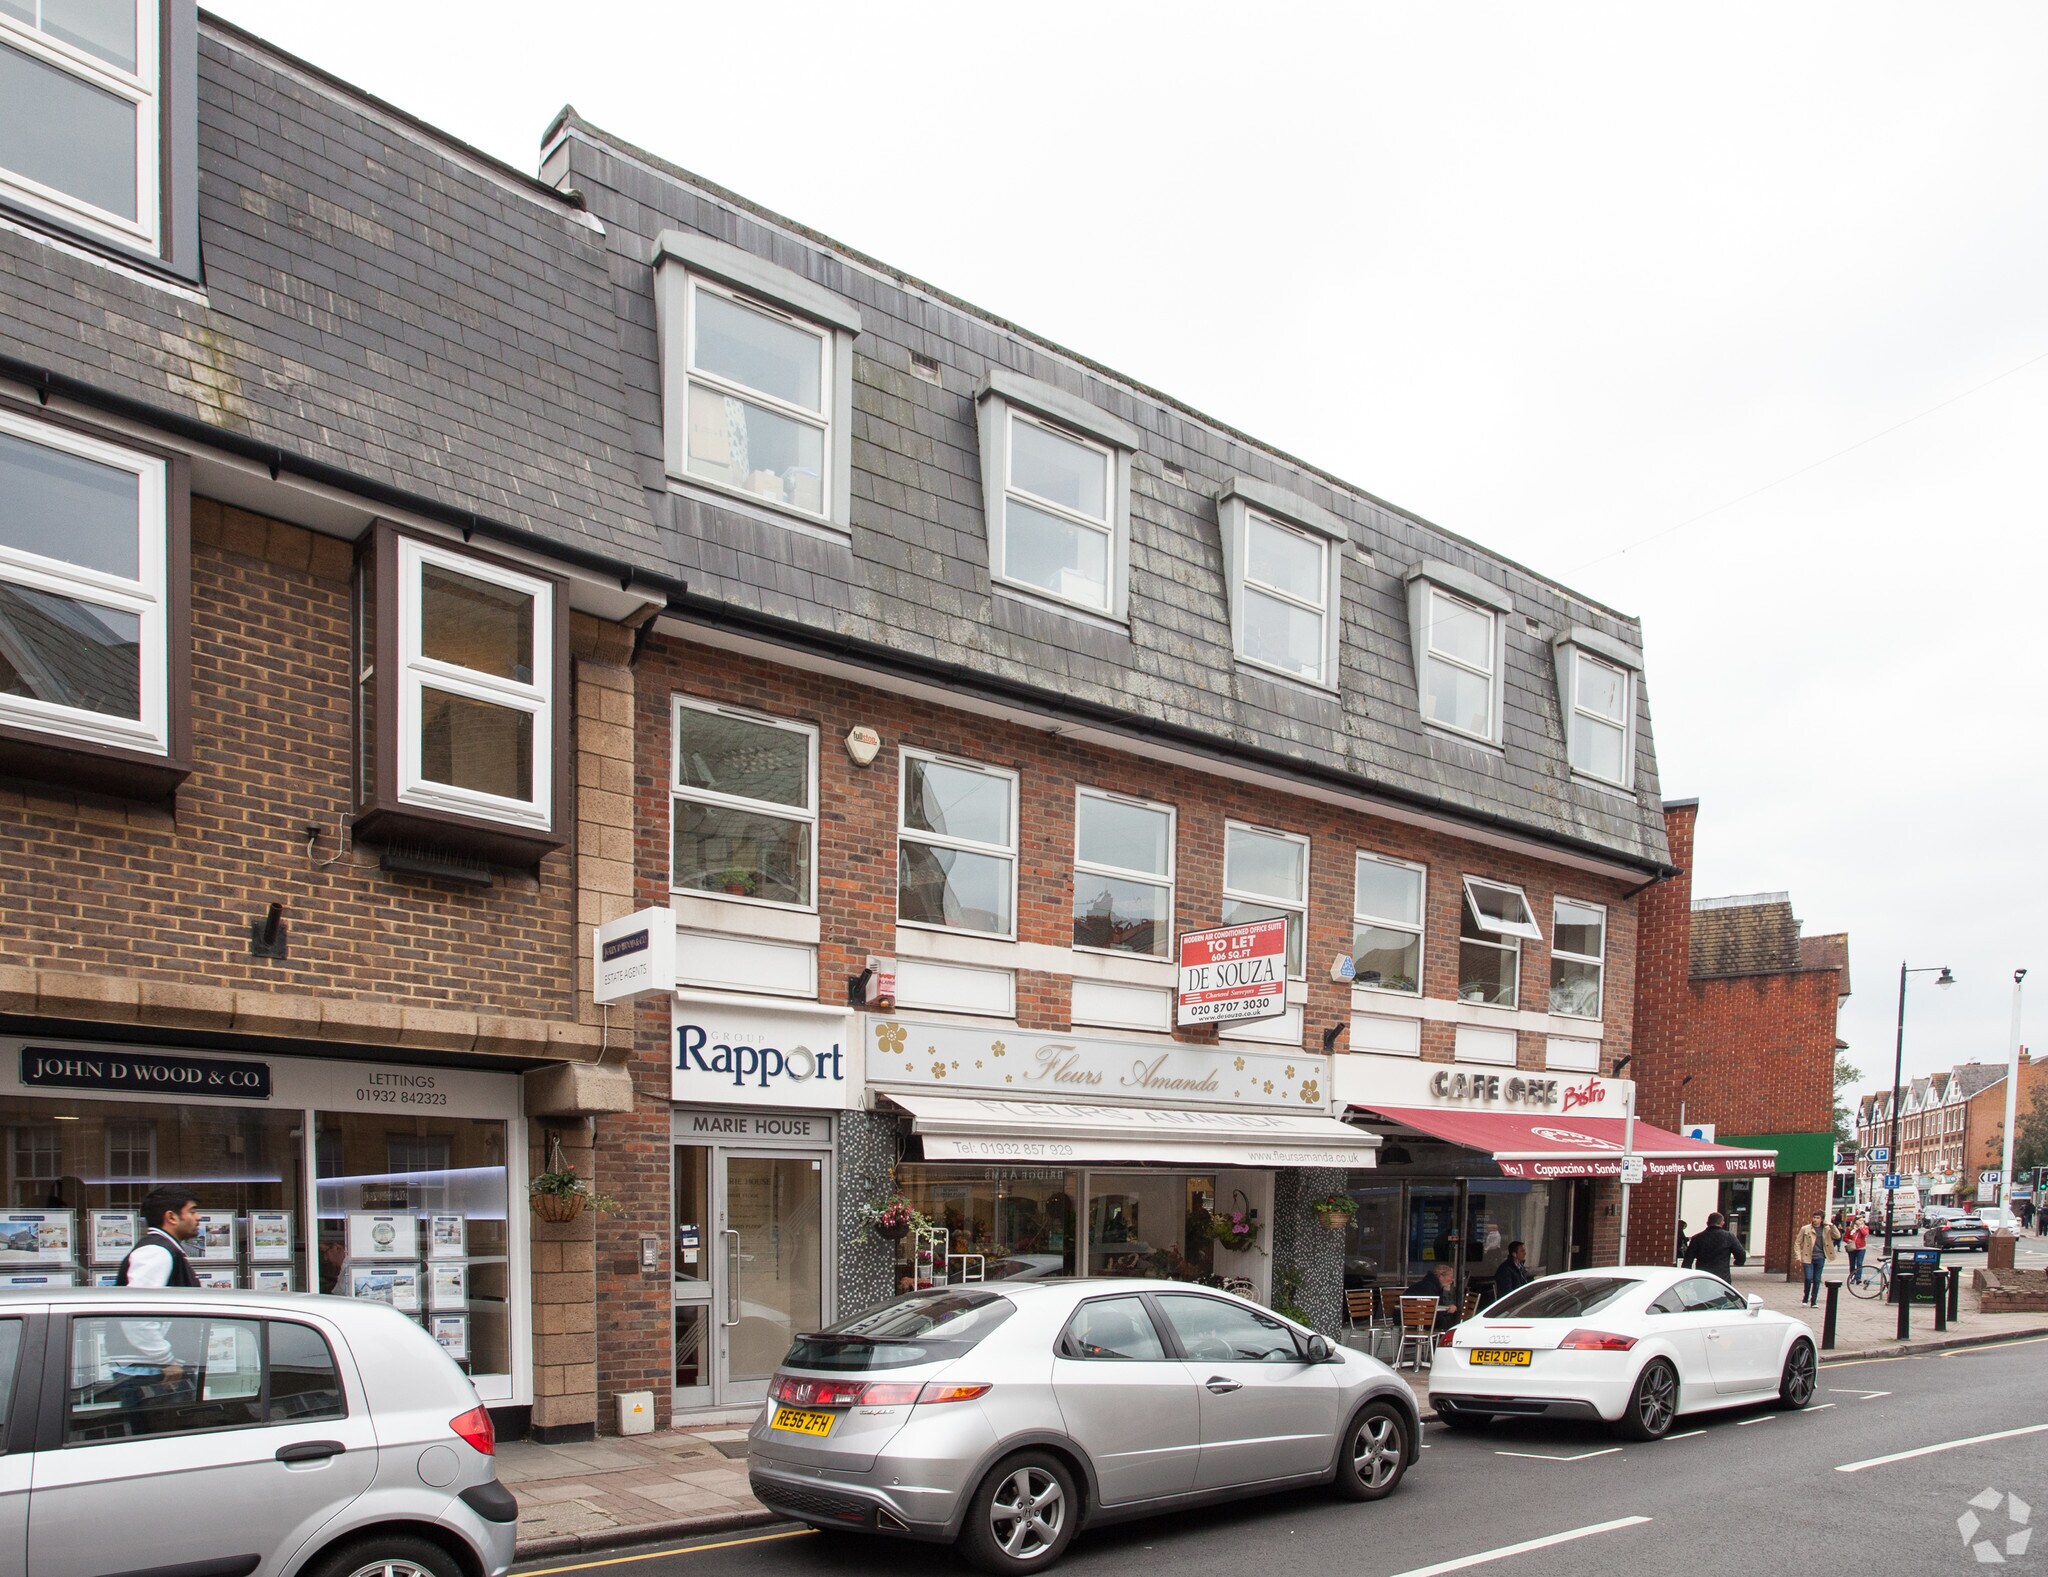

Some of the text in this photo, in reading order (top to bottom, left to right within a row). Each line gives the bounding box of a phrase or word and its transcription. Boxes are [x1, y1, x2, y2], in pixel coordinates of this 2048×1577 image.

[1184, 935, 1204, 945] MODERN
[1214, 928, 1248, 939] CONDITIONED
[1250, 925, 1267, 934] OFFICE
[1268, 922, 1282, 931] SUITE
[1207, 935, 1256, 953] TO LET
[1212, 949, 1250, 962] 606 SQ.FT
[604, 963, 647, 986] ESTATE AGENTS
[1189, 958, 1275, 991] DE SOUZA
[1206, 988, 1254, 999] Chartered Surveyors
[1191, 998, 1269, 1016] 020 8707 3030
[1198, 1010, 1261, 1022] www.desouza.co.uk
[711, 1031, 766, 1044] GROUP
[676, 1024, 844, 1088] Rapport
[33, 1058, 260, 1088] JOHN D WOOD & CO.
[1024, 1044, 1220, 1092] Fleurs Amanda
[369, 1072, 435, 1088] LETTINGS
[356, 1088, 447, 1105] 01932 842323
[1430, 1070, 1606, 1113] CAFE ONE Bistro
[975, 1100, 1296, 1128] FLEURS AMANDA
[693, 1116, 810, 1136] MARIE HOUSE
[952, 1141, 1073, 1156] Tel: 01932 857 929
[1248, 1151, 1359, 1163] www.fleursamanda.co.uk
[1534, 1162, 1585, 1176] Cappuccino
[1650, 1162, 1686, 1176] Baguettes
[1693, 1162, 1715, 1172] Cakes
[1726, 1160, 1748, 1170] 01932
[1748, 1160, 1761, 1170] 841
[1762, 1160, 1774, 1170] 844
[1477, 1351, 1524, 1362] RE12 OPG
[776, 1410, 830, 1432] RE56 ZFH
